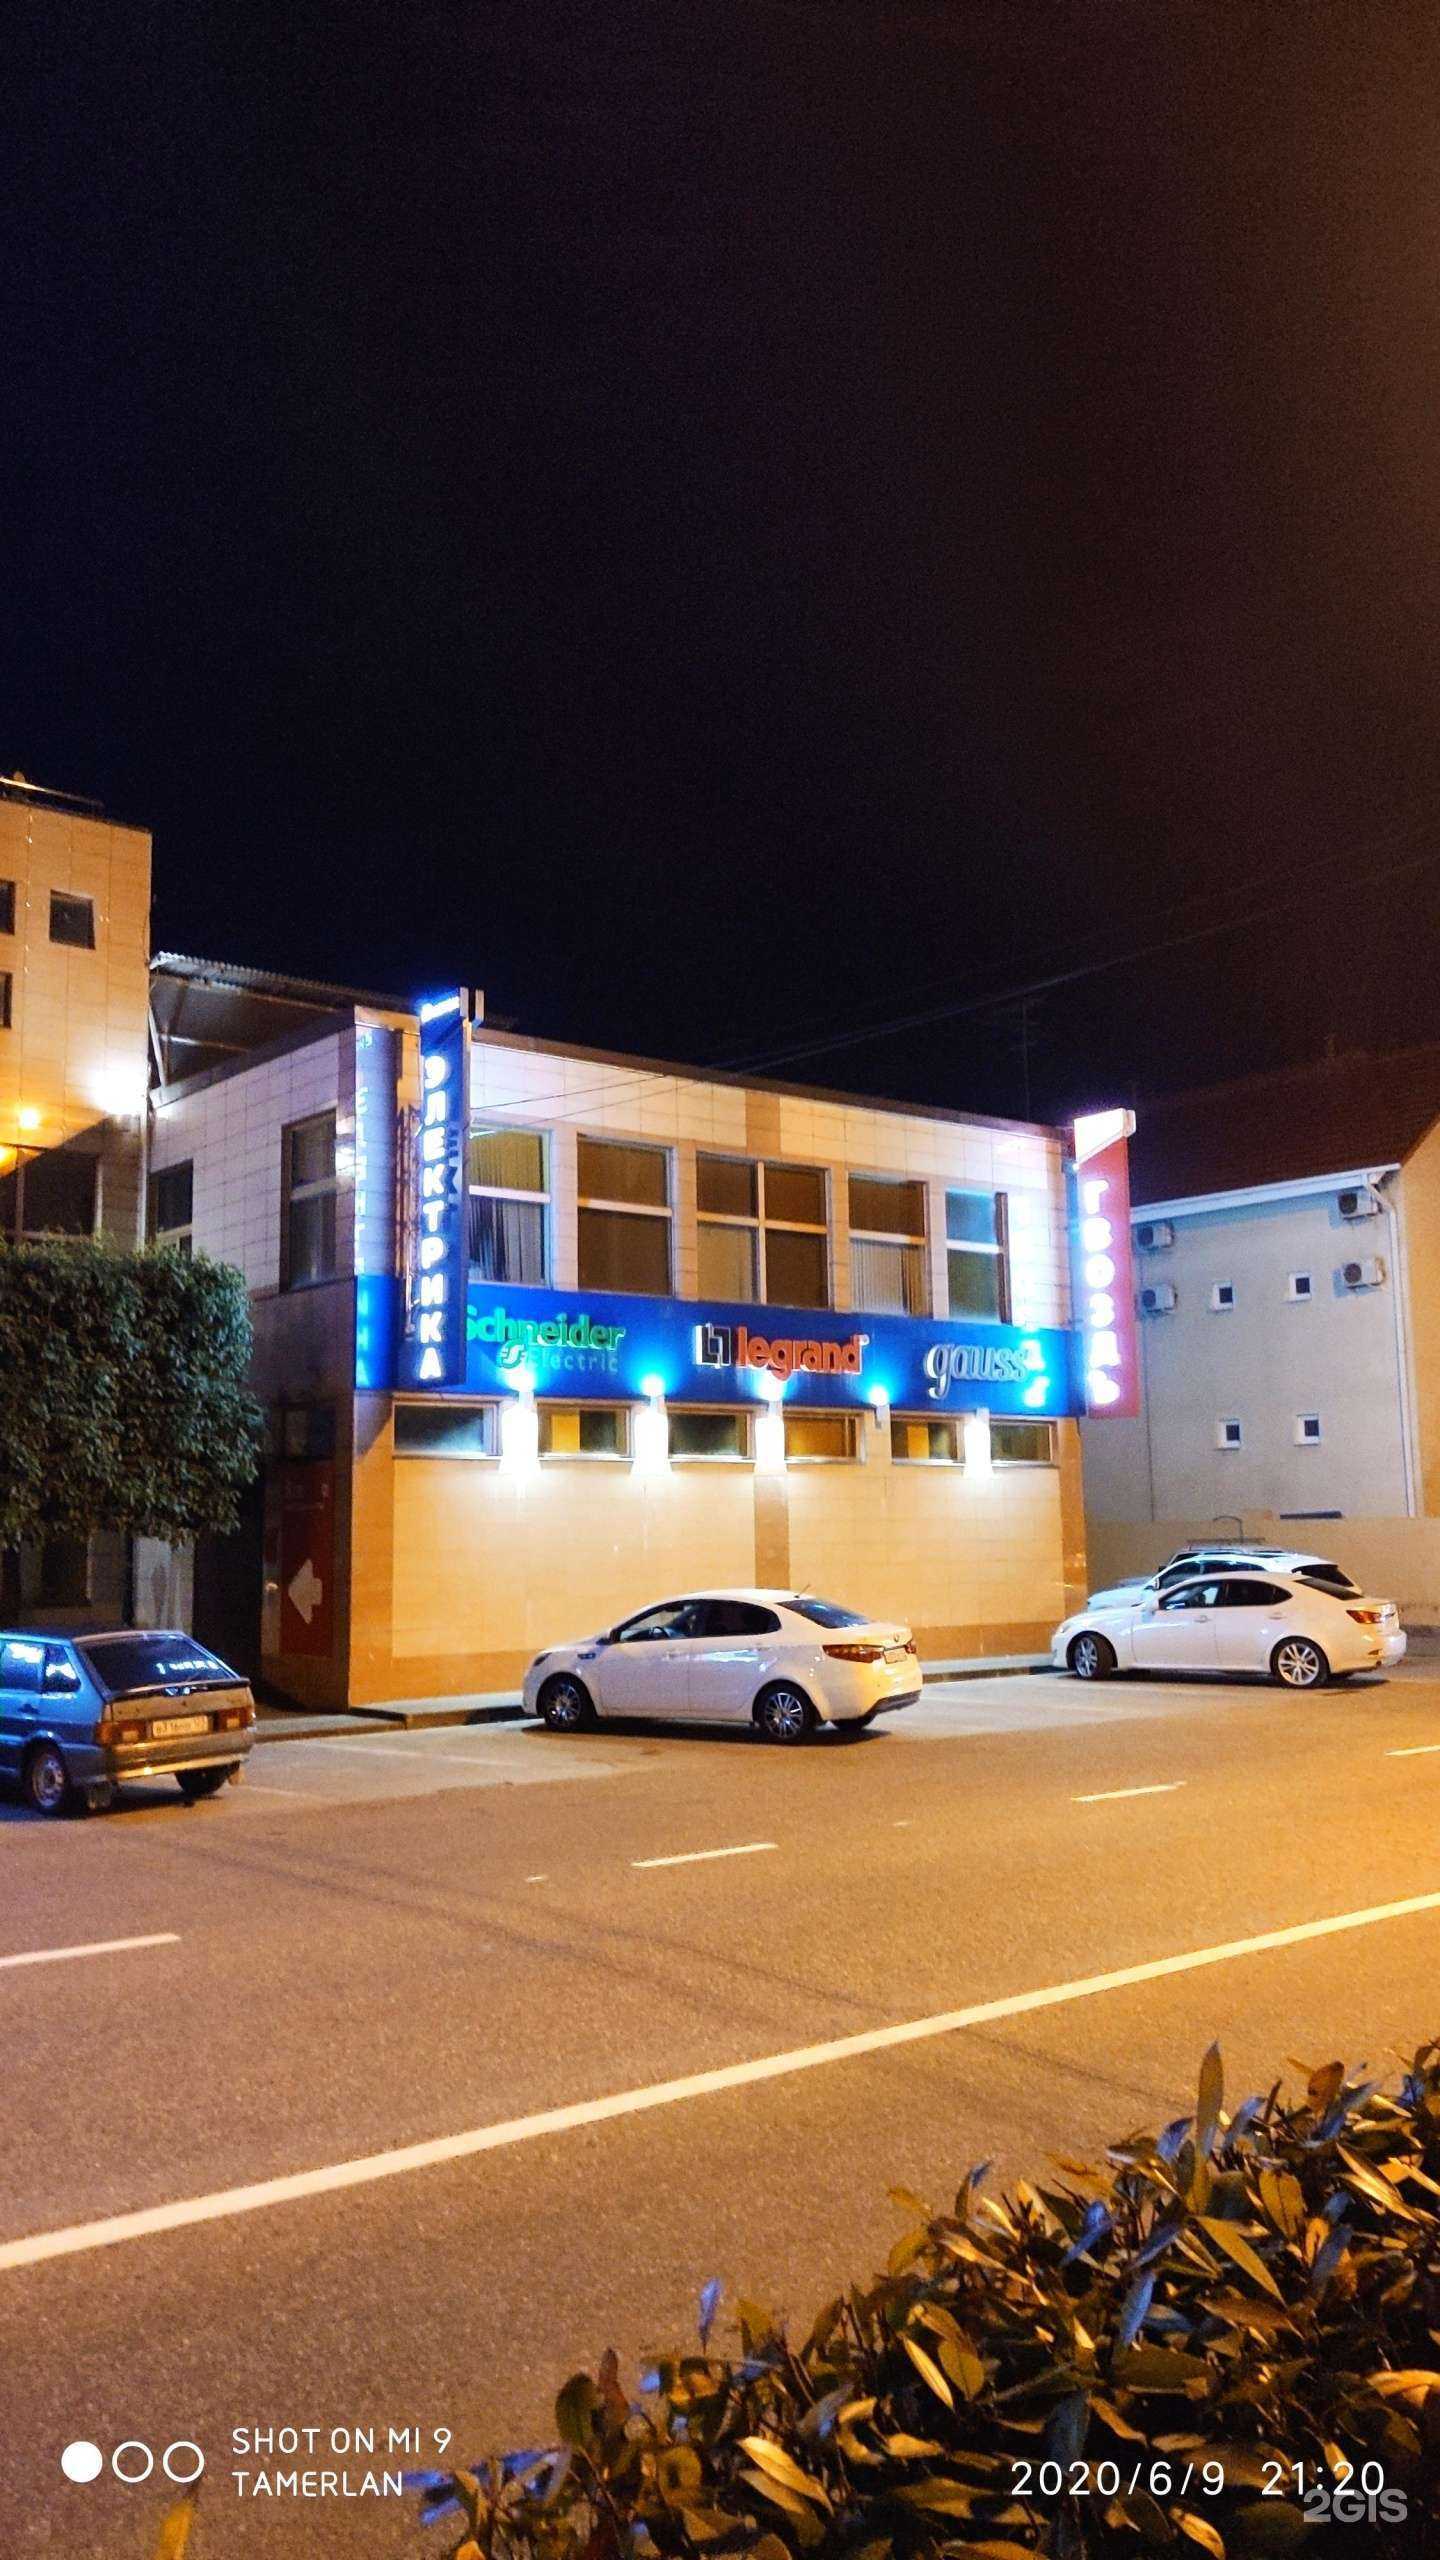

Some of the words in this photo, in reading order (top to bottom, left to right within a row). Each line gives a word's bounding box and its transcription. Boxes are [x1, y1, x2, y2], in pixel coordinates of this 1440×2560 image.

[419, 1054, 449, 1379] ЭЛЕКТРИКА
[526, 1348, 619, 1373] Electric
[737, 1326, 862, 1381] legrand
[923, 1342, 1029, 1400] gauss
